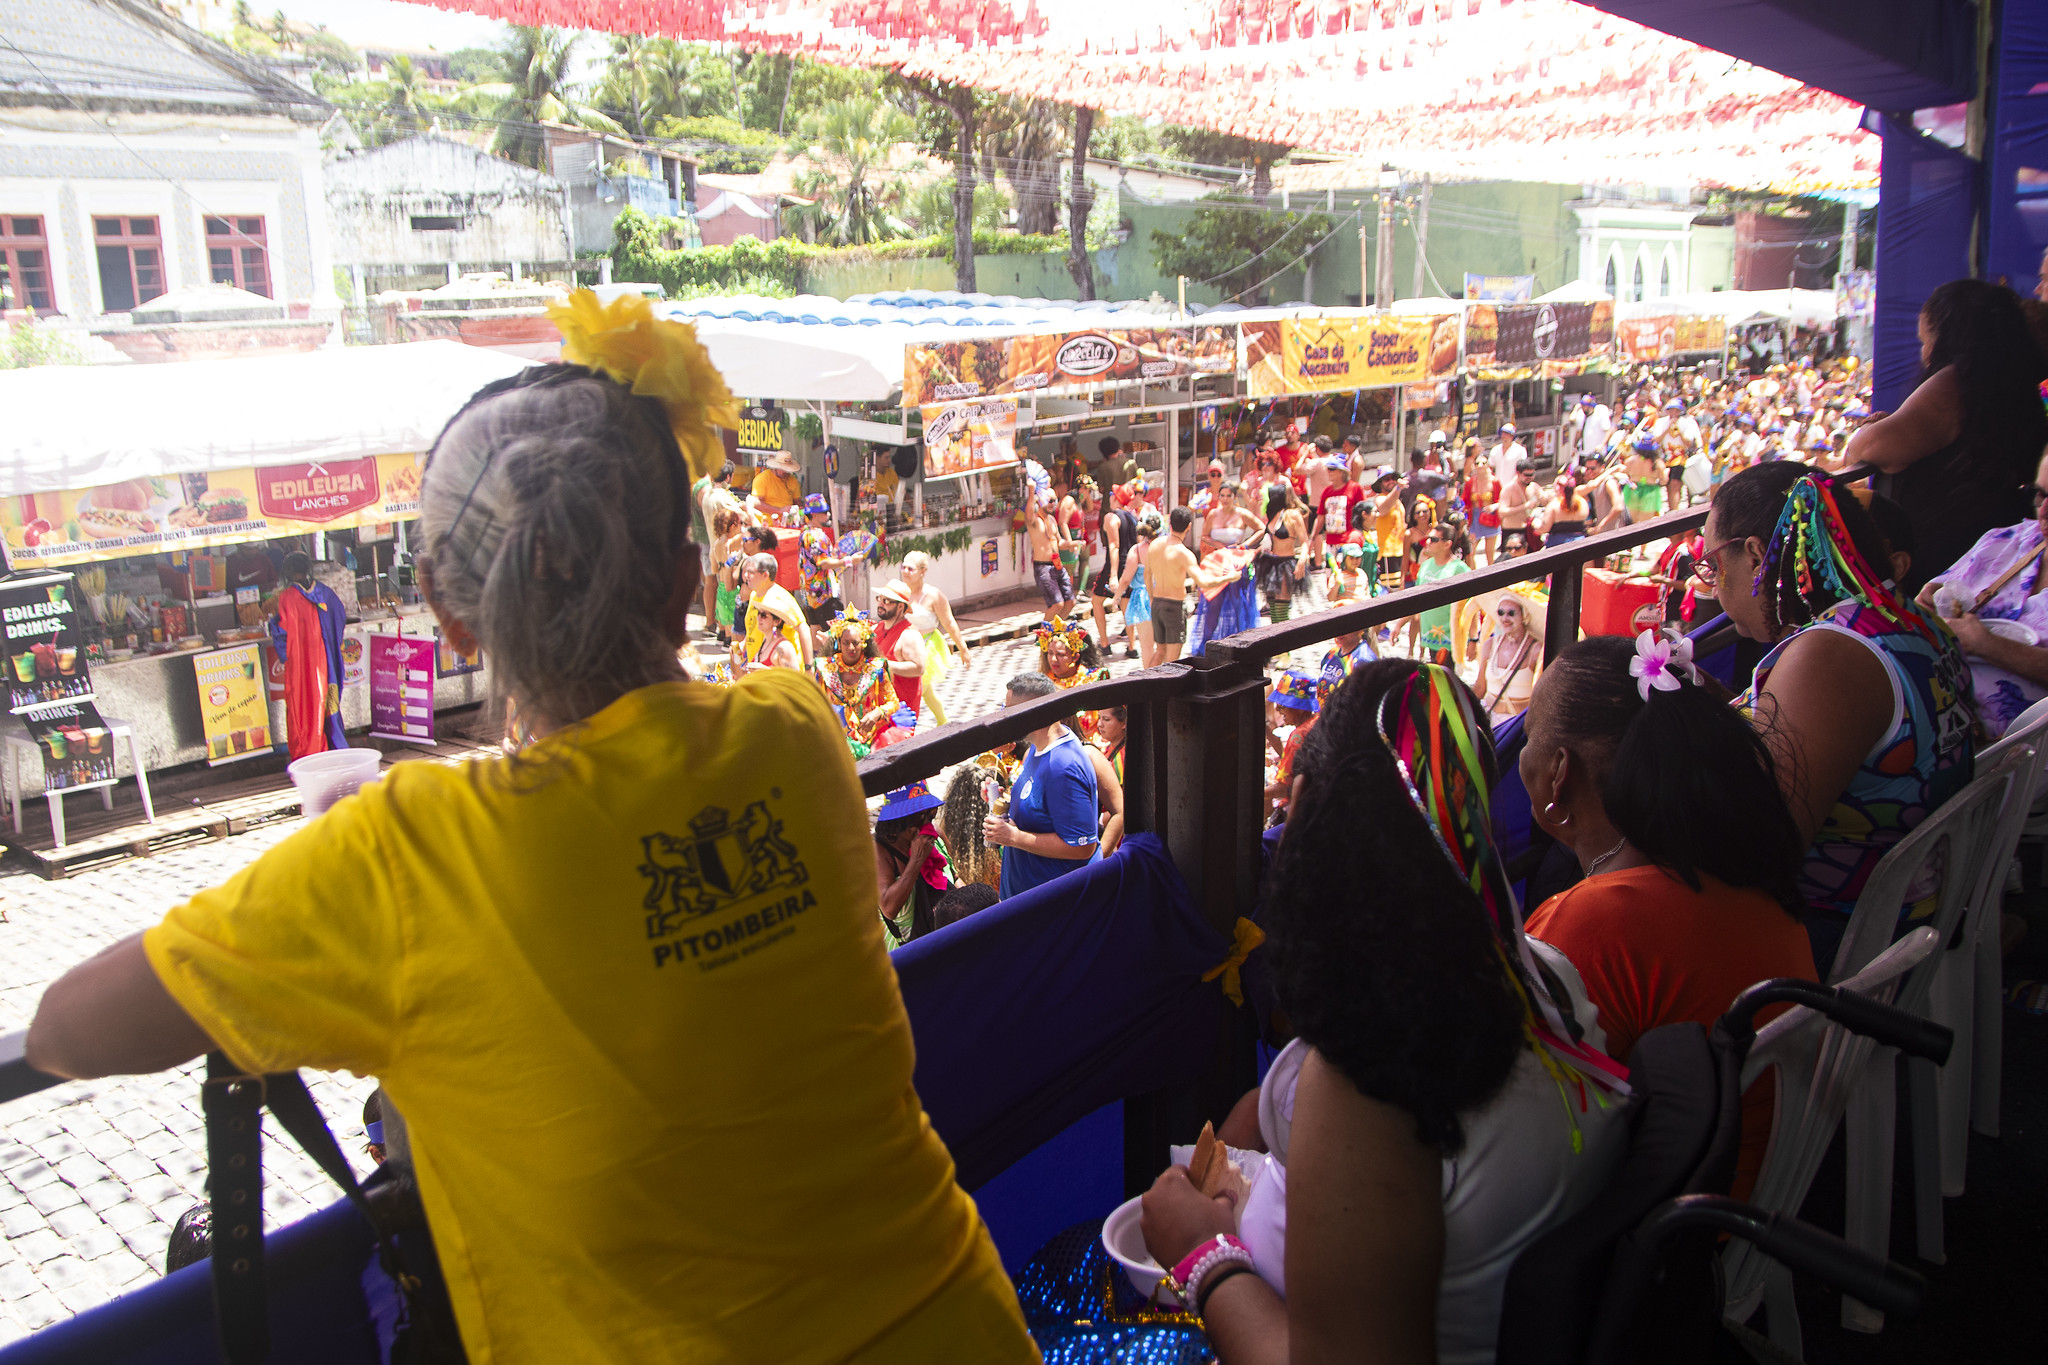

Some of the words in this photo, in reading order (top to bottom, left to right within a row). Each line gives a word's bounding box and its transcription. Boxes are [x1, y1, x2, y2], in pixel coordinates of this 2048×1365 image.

[1371, 331, 1399, 348] Super
[1304, 344, 1328, 359] Casa
[1368, 346, 1418, 367] Cachorrão
[738, 418, 782, 450] BEBIDAS
[270, 473, 366, 500] EDILEUZA
[293, 494, 349, 511] LANCHES
[2, 599, 73, 622] EDILEUSA
[6, 617, 67, 639] DRINKS.
[196, 651, 250, 671] EDILEUSA
[653, 889, 818, 968] PITOMBEIRA
